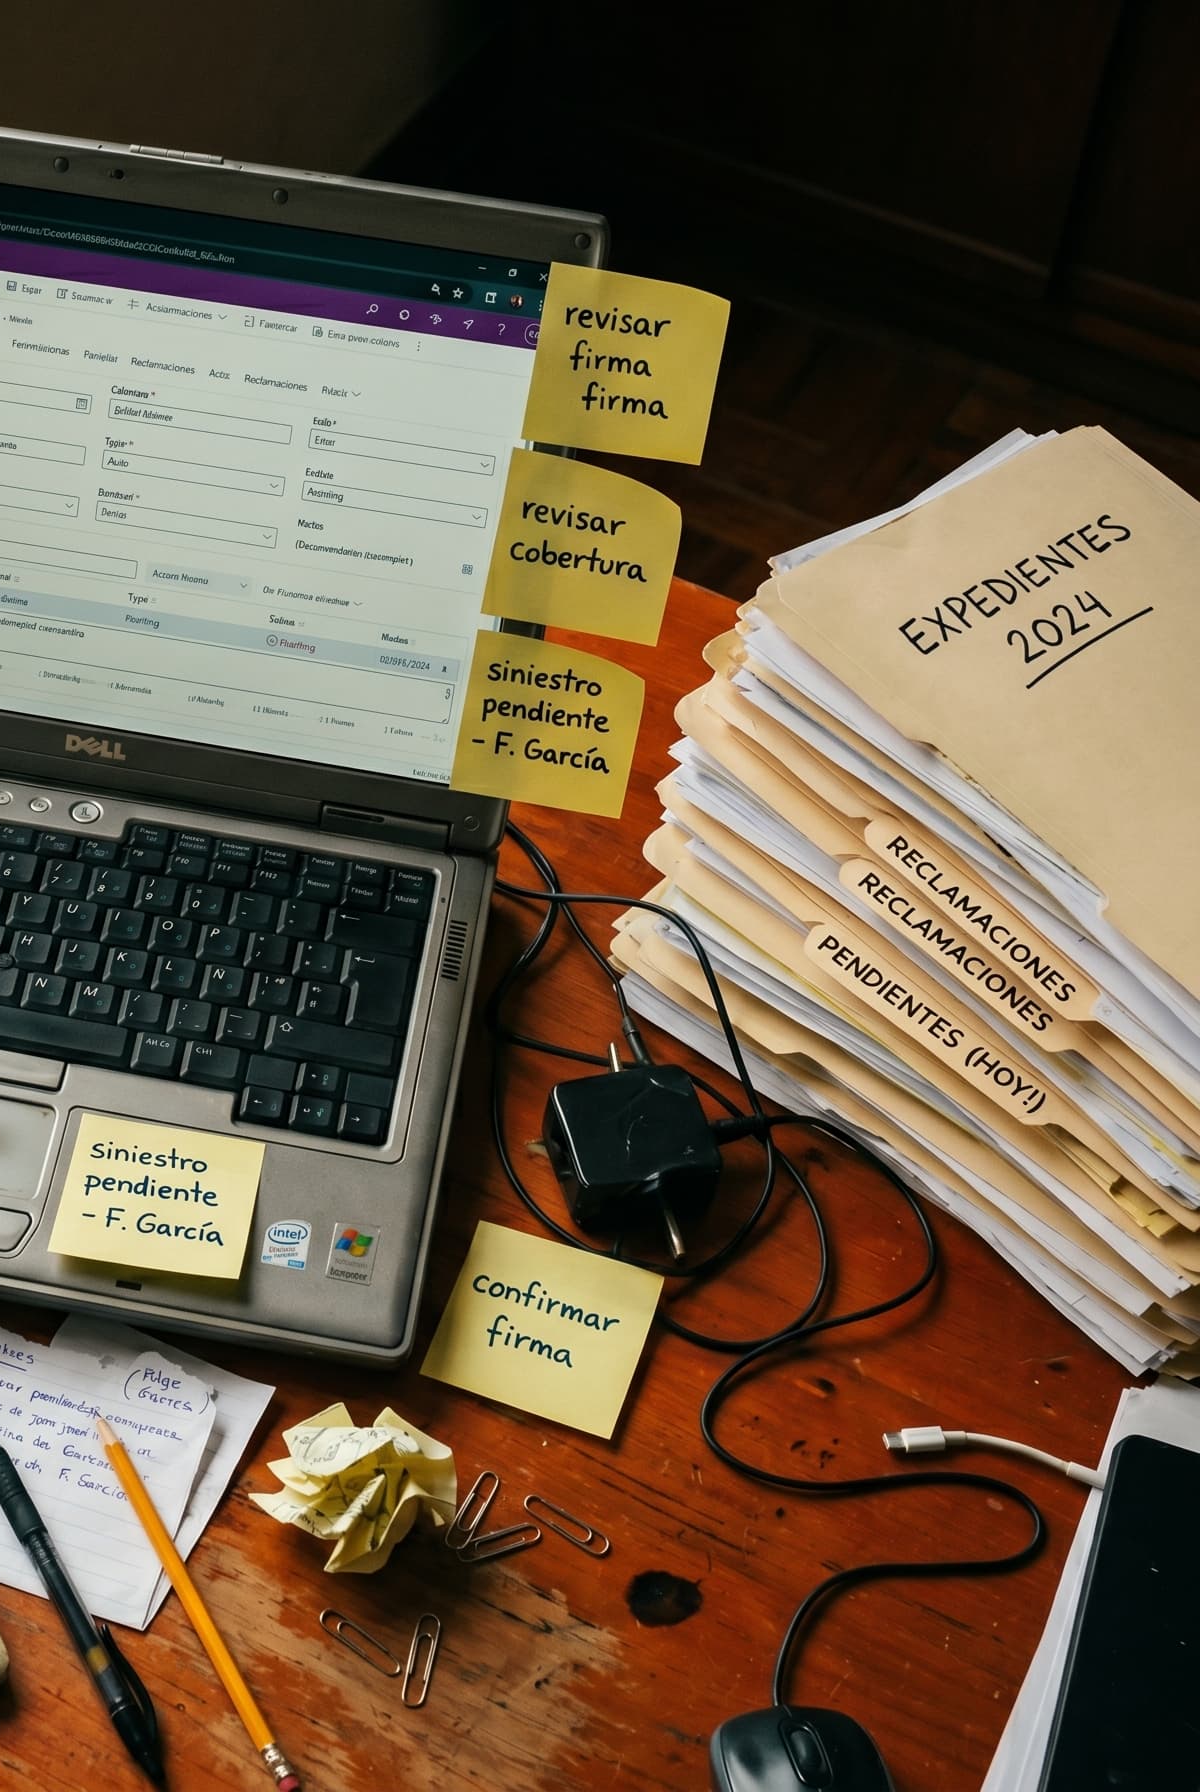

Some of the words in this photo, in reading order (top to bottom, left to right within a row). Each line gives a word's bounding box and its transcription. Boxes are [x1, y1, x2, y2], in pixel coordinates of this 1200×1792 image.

[565, 306, 671, 337] revisar
[569, 340, 651, 377] firma
[581, 381, 668, 419] firma
[522, 500, 626, 535] revisar
[127, 593, 148, 604] Type
[898, 514, 1131, 655] EXPEDIENTES
[1006, 590, 1112, 663] 2024
[487, 660, 602, 696] siniestro
[482, 696, 610, 733] pendiente
[65, 734, 126, 760] DELL
[494, 731, 514, 756] F.
[524, 738, 610, 774] García
[23, 896, 32, 905] Y
[67, 904, 79, 913] U
[115, 912, 120, 920] I
[210, 928, 220, 937] P
[886, 835, 1076, 1002] RECLAMACIONES
[21, 936, 34, 945] H
[69, 943, 78, 953] J
[117, 952, 127, 961] K
[858, 872, 1054, 1033] RECLAMACIONES
[165, 960, 173, 970] L
[35, 978, 48, 988] N
[83, 987, 98, 997] M
[818, 934, 965, 1049] PENDIENTES
[965, 1046, 1046, 1114] (HOY!)
[90, 1142, 208, 1173] siniestro
[84, 1174, 219, 1207] pendiente
[105, 1208, 127, 1231] F.
[136, 1213, 224, 1247] García
[272, 1226, 301, 1241] intel
[472, 1274, 620, 1332] confirmar
[486, 1314, 573, 1368] firma
